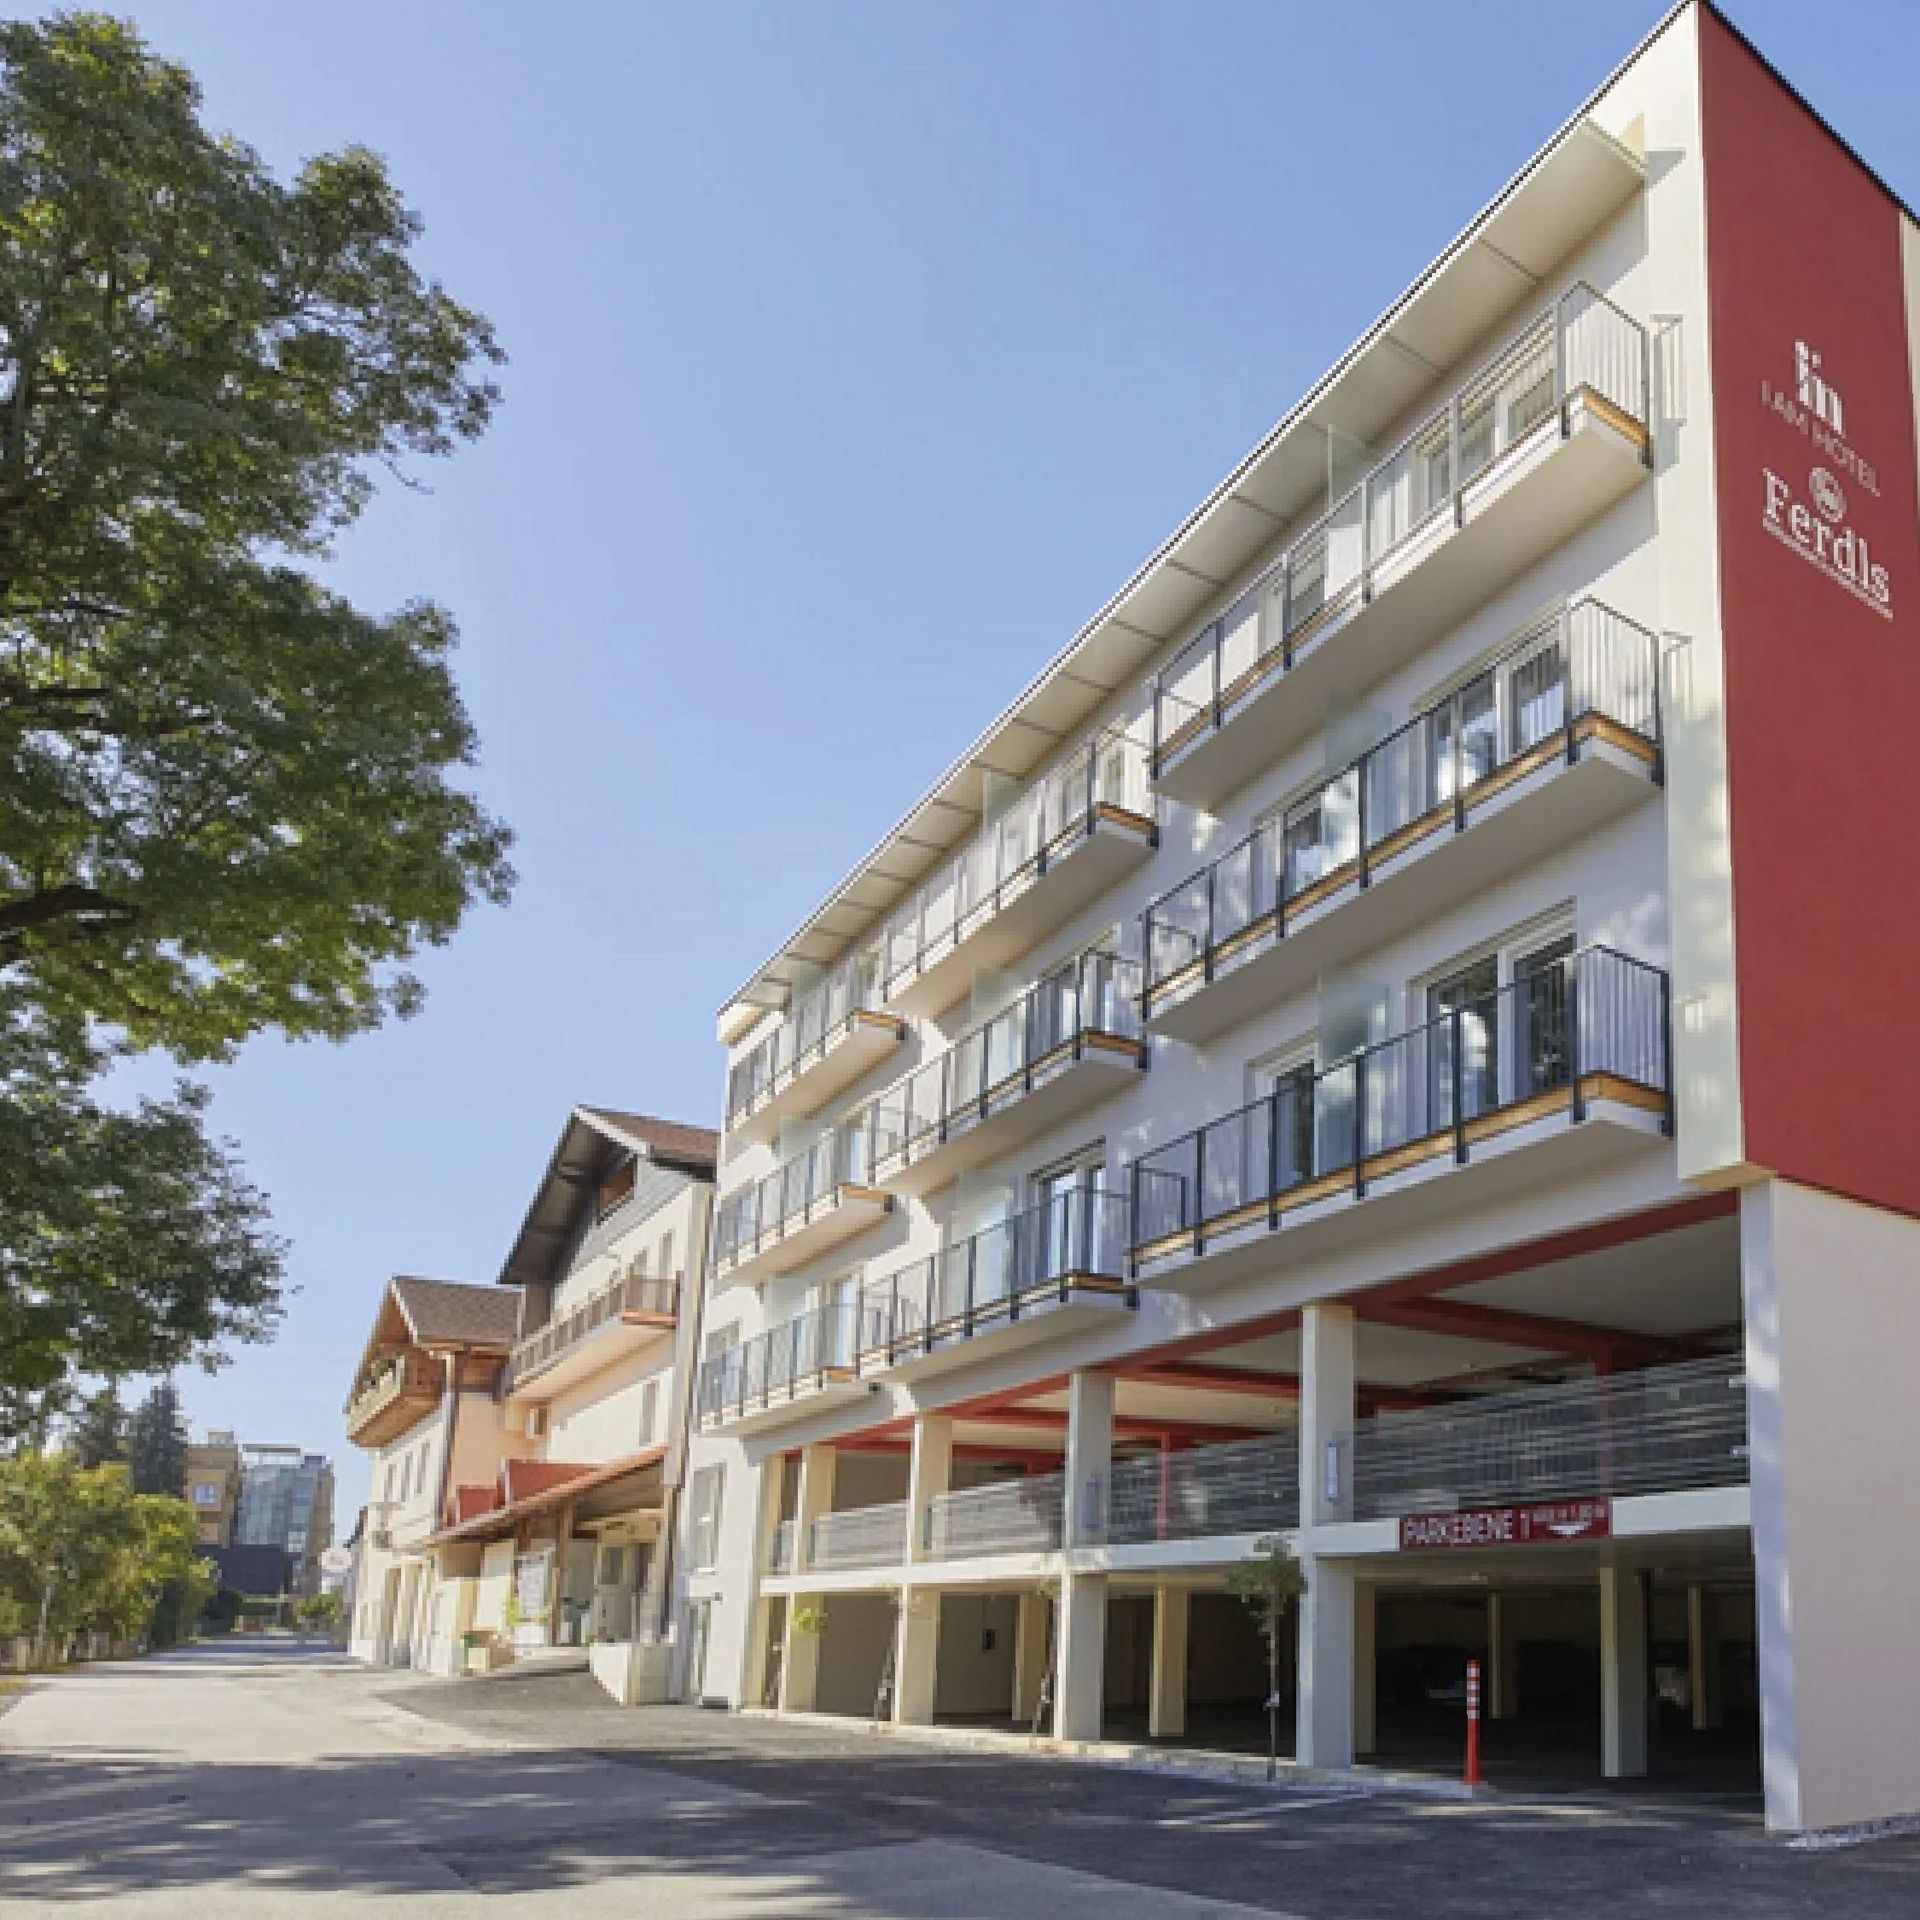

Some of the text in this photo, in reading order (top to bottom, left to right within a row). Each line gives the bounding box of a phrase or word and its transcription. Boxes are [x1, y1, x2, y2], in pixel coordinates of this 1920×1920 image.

[1812, 420, 1881, 497] HOTEL
[1762, 467, 1890, 603] Ferdls
[1403, 1509, 1513, 1545] PARKEBENE
